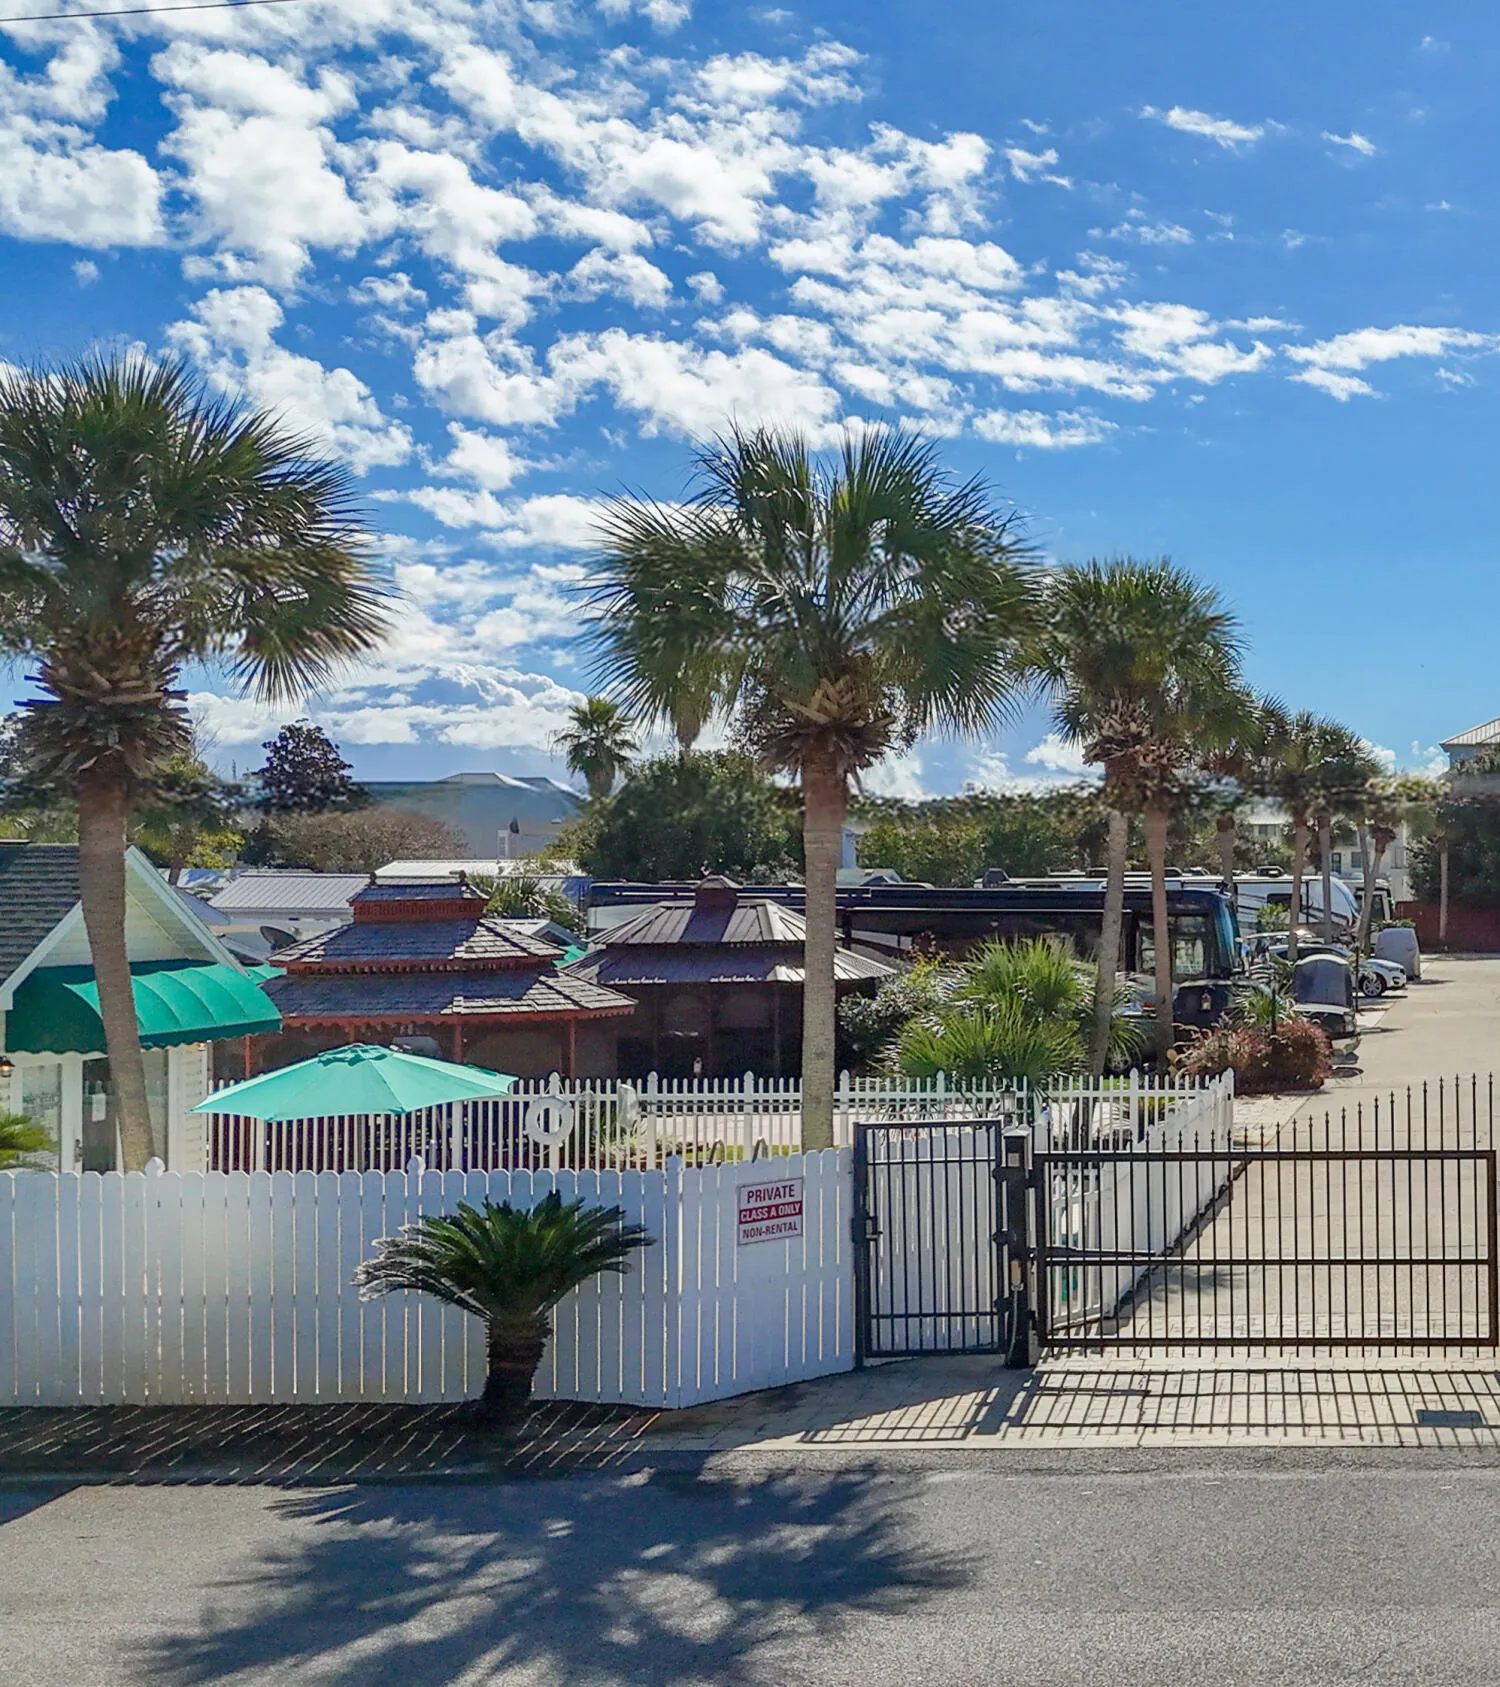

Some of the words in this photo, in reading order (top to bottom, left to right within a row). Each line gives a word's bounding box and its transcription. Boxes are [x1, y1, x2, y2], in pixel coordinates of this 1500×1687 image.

[747, 1184, 795, 1204] PRIVATE
[741, 1207, 768, 1222] CLASS
[770, 1207, 777, 1218] A
[779, 1203, 800, 1216] ONLY
[742, 1221, 798, 1239] NON-RENTAL
